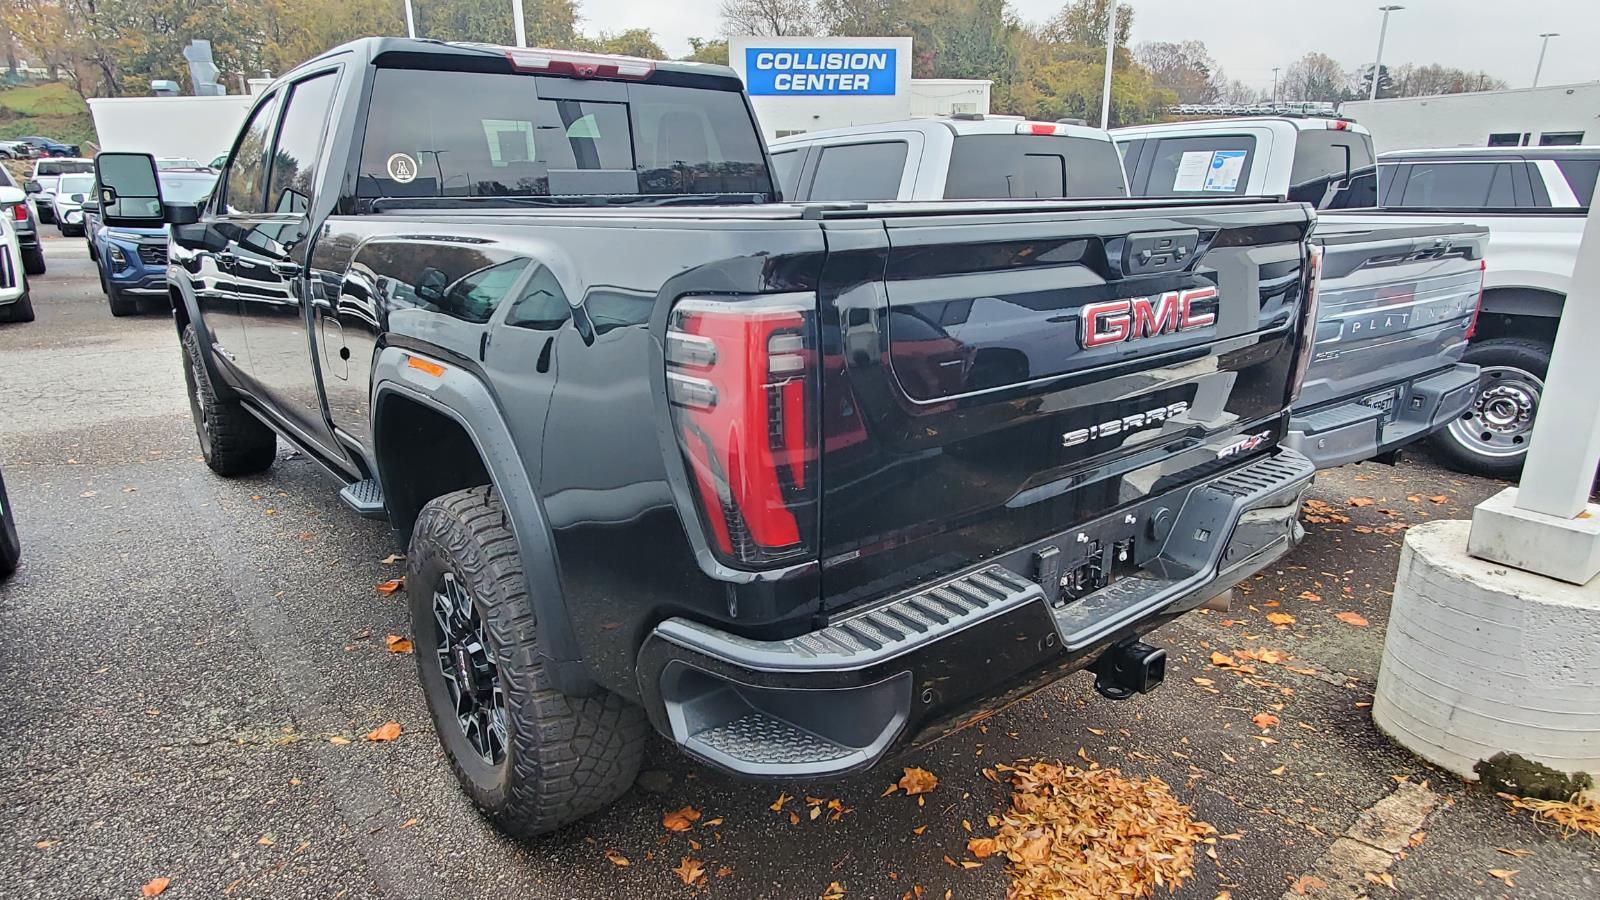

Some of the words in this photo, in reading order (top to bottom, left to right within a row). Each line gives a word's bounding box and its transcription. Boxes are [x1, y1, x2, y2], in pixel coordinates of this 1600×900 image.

[756, 53, 887, 70] COLLISION
[774, 74, 870, 91] CENTER
[1079, 286, 1219, 349] GMC
[1062, 401, 1188, 447] SIERRA
